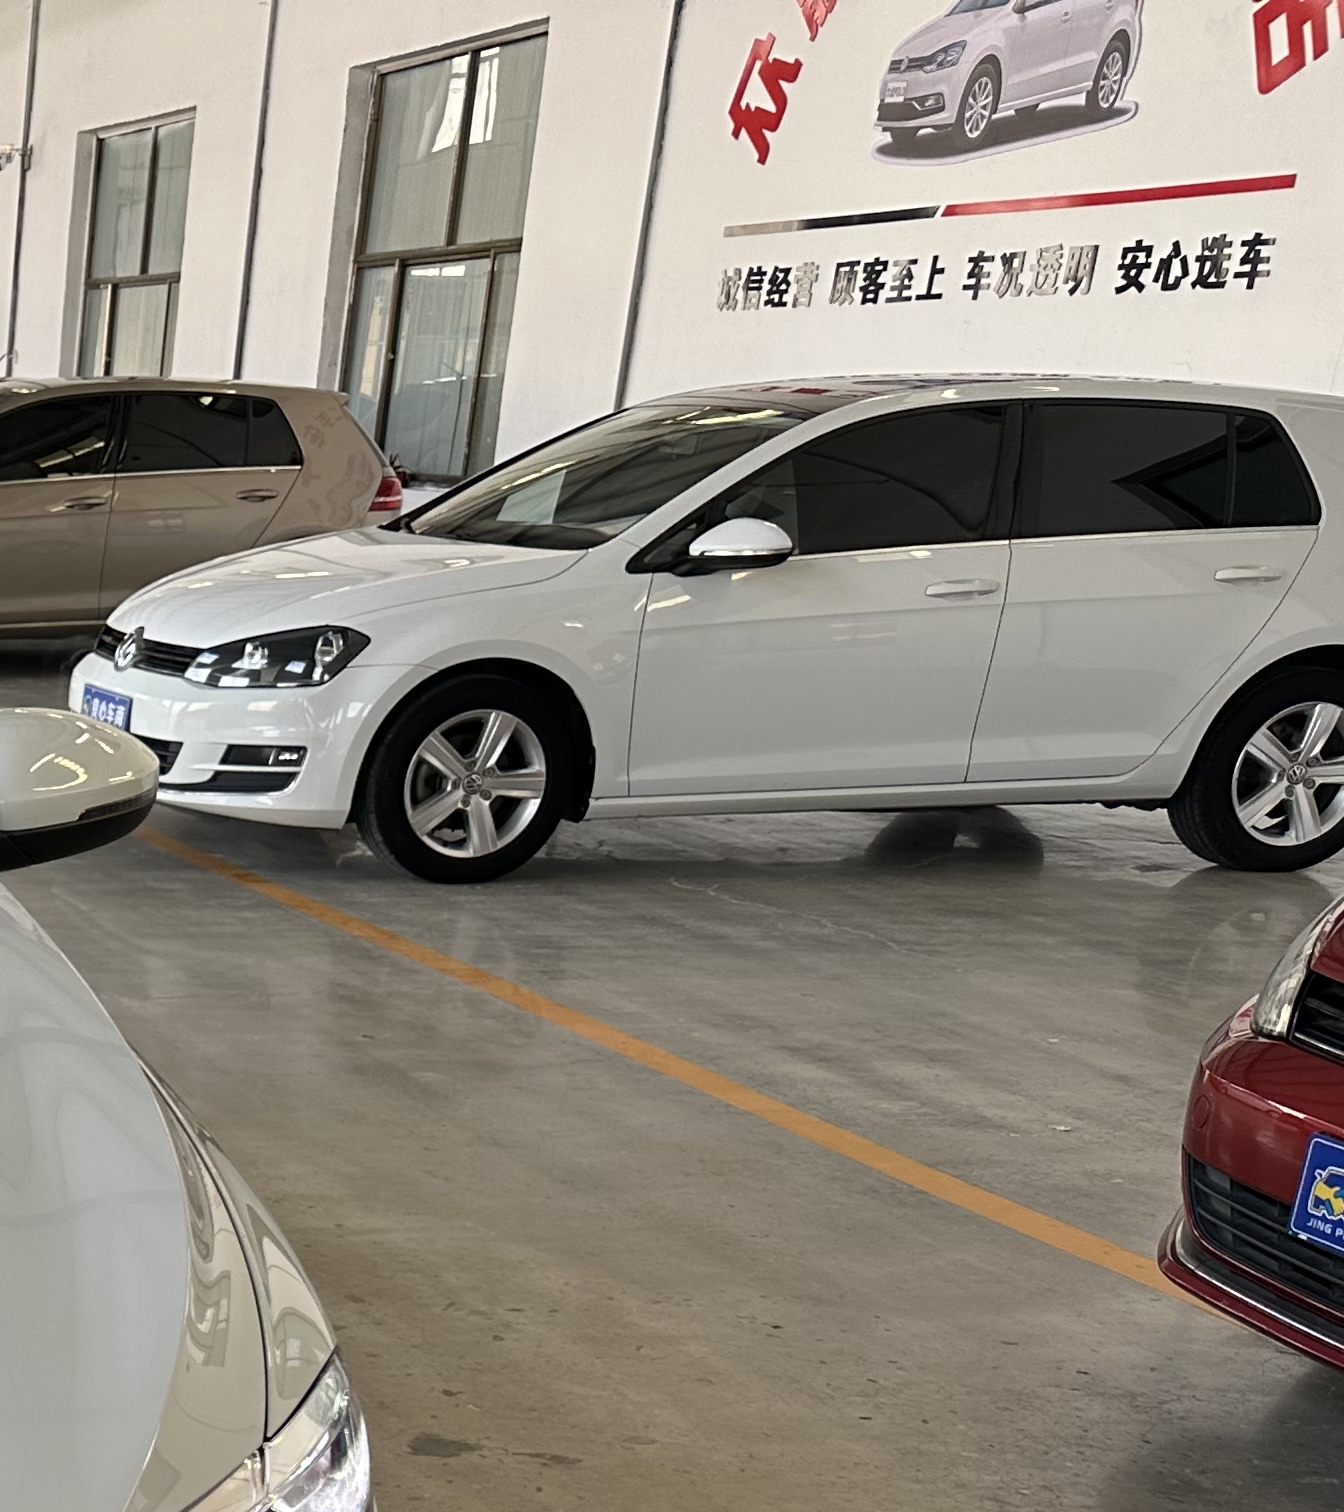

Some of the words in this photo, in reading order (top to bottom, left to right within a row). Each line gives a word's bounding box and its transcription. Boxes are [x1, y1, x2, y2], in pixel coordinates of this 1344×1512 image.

[716, 261, 819, 311] 诚信经营
[828, 254, 946, 306] 顾客至上
[961, 243, 1100, 301] 车况透明
[1114, 232, 1277, 295] 安心选车
[1306, 1217, 1334, 1234] JING
